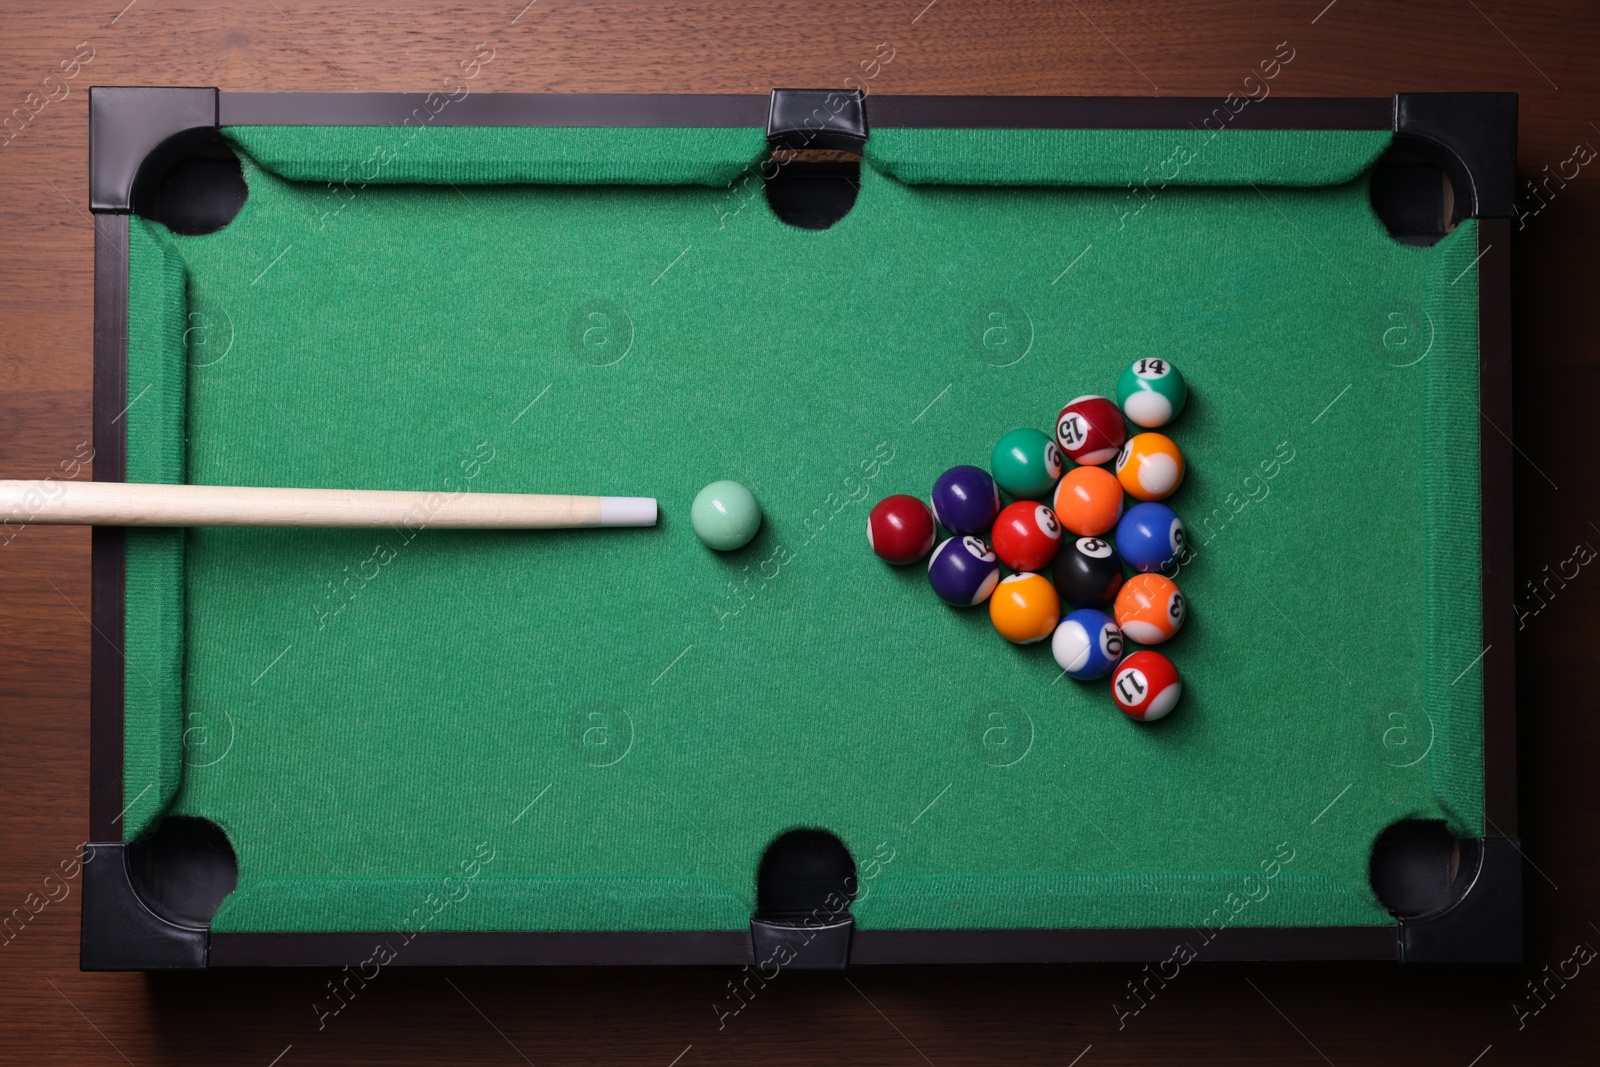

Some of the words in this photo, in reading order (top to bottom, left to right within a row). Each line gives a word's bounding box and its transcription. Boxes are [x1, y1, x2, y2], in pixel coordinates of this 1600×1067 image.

[1137, 358, 1165, 375] 14
[1059, 417, 1084, 445] 15
[1043, 508, 1059, 532] 3
[1084, 538, 1106, 552] 8
[1105, 627, 1123, 656] 10
[1116, 670, 1144, 703] 11
